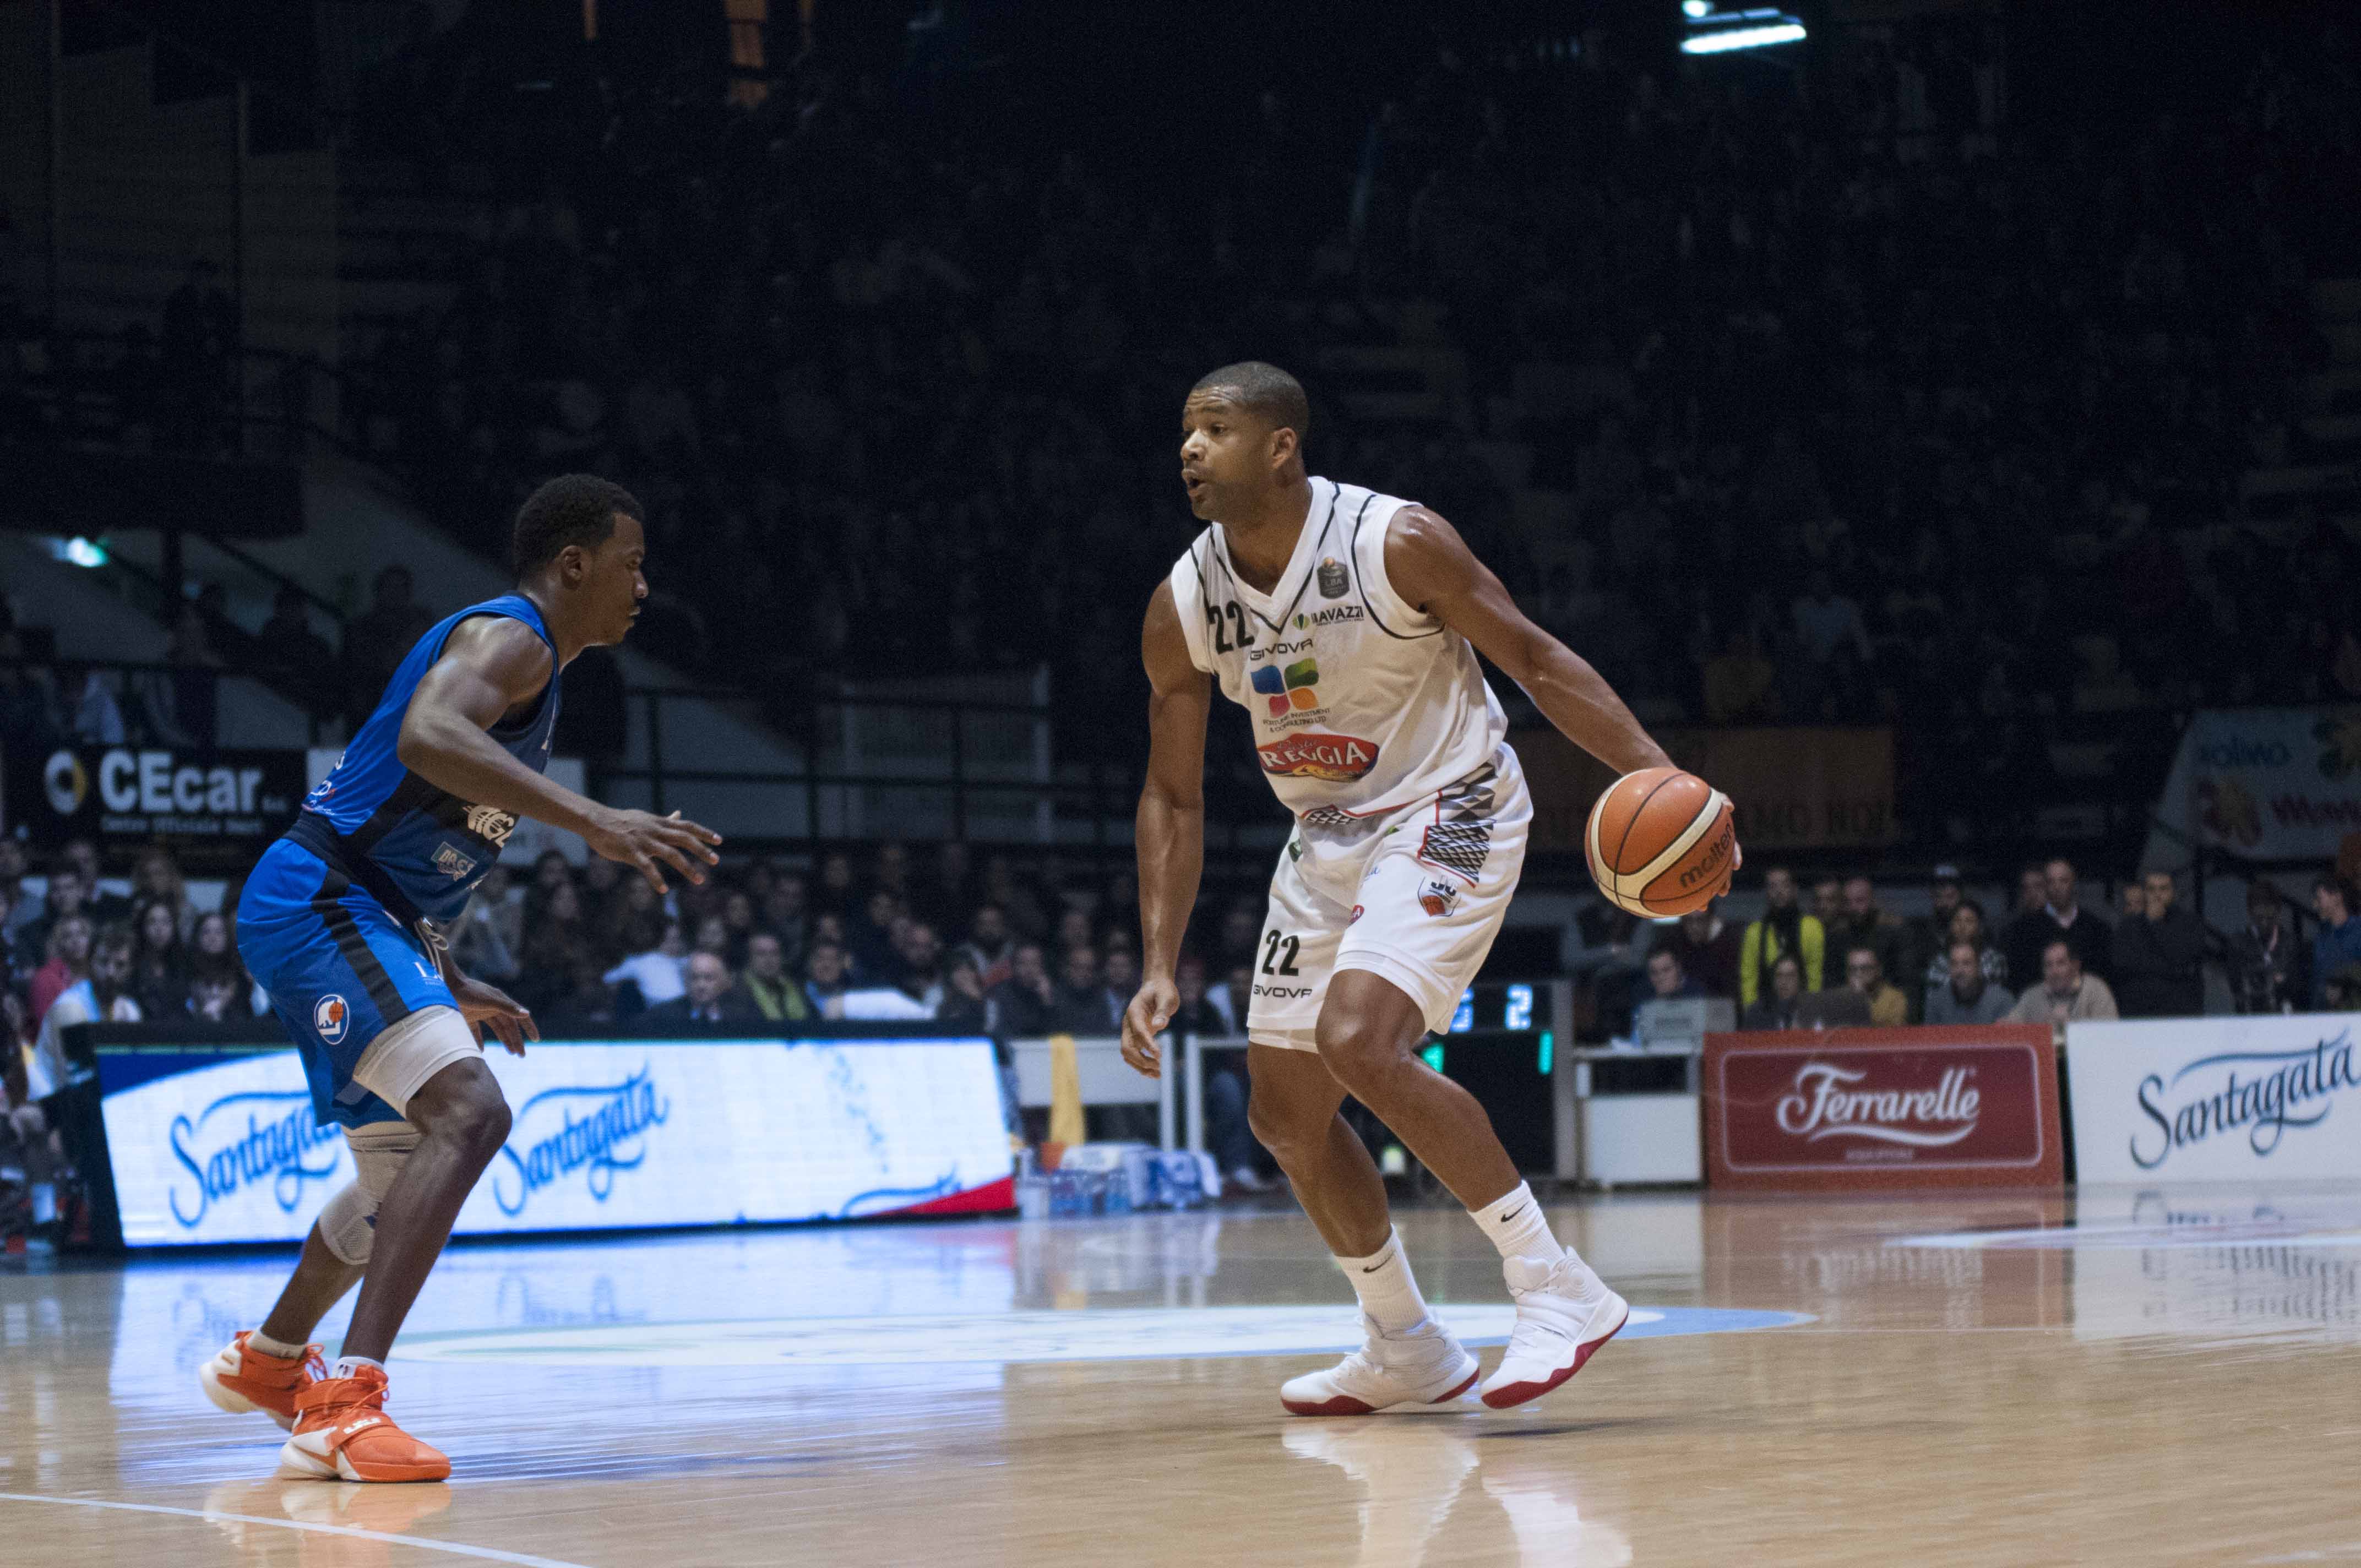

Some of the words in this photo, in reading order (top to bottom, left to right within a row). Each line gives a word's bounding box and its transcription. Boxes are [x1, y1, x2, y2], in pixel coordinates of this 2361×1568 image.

[1207, 601, 1255, 655] 22
[1250, 638, 1313, 660] GIVOVA
[99, 748, 264, 813] CEcar
[1680, 822, 1732, 888] molten
[1261, 929, 1300, 977] 22
[1777, 1062, 1981, 1134] Ferrarelle
[2130, 1026, 2361, 1169] Santagata
[169, 1092, 342, 1228] Santaga
